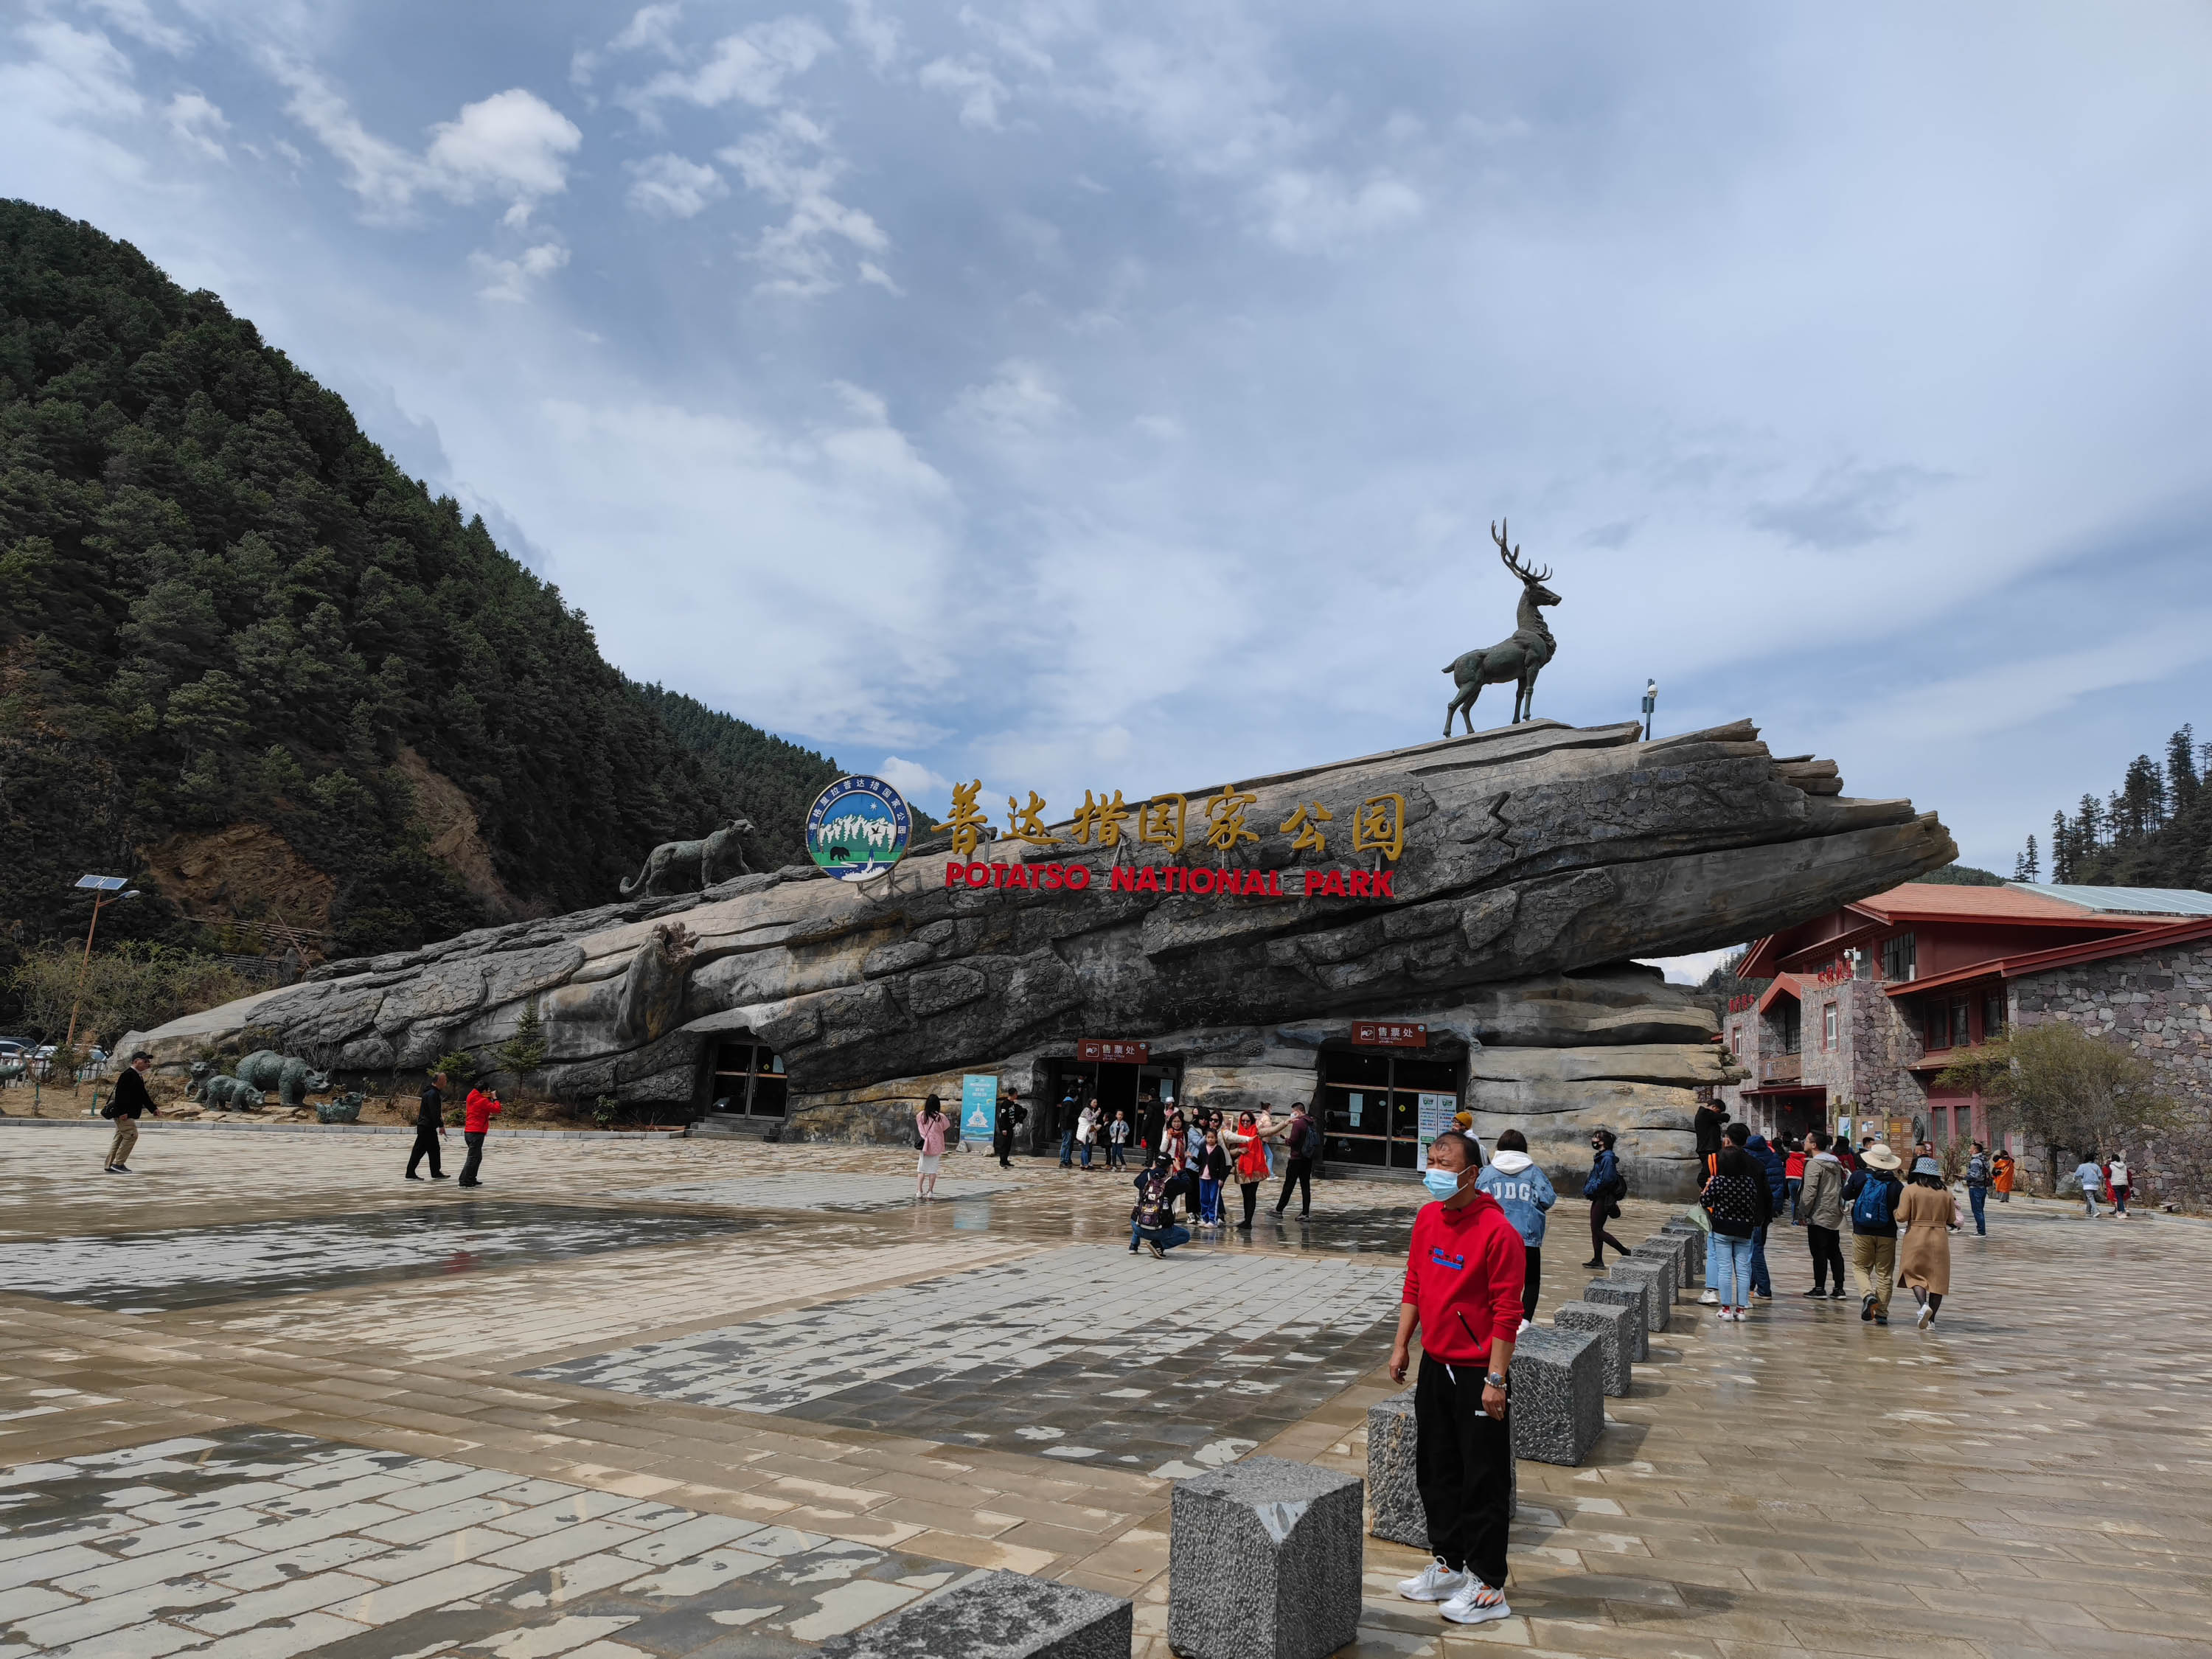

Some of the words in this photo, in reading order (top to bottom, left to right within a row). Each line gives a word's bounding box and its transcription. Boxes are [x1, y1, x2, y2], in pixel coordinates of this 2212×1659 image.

[809, 779, 906, 834] 香格里拉普达措国家公园
[931, 779, 1405, 861] 普达措国家公园
[945, 862, 1091, 890] POTATSO
[1111, 867, 1283, 897] NATIONAL
[1304, 871, 1394, 897] PARK
[1378, 1026, 1413, 1037] 售票处
[1102, 1044, 1135, 1055] 售票处
